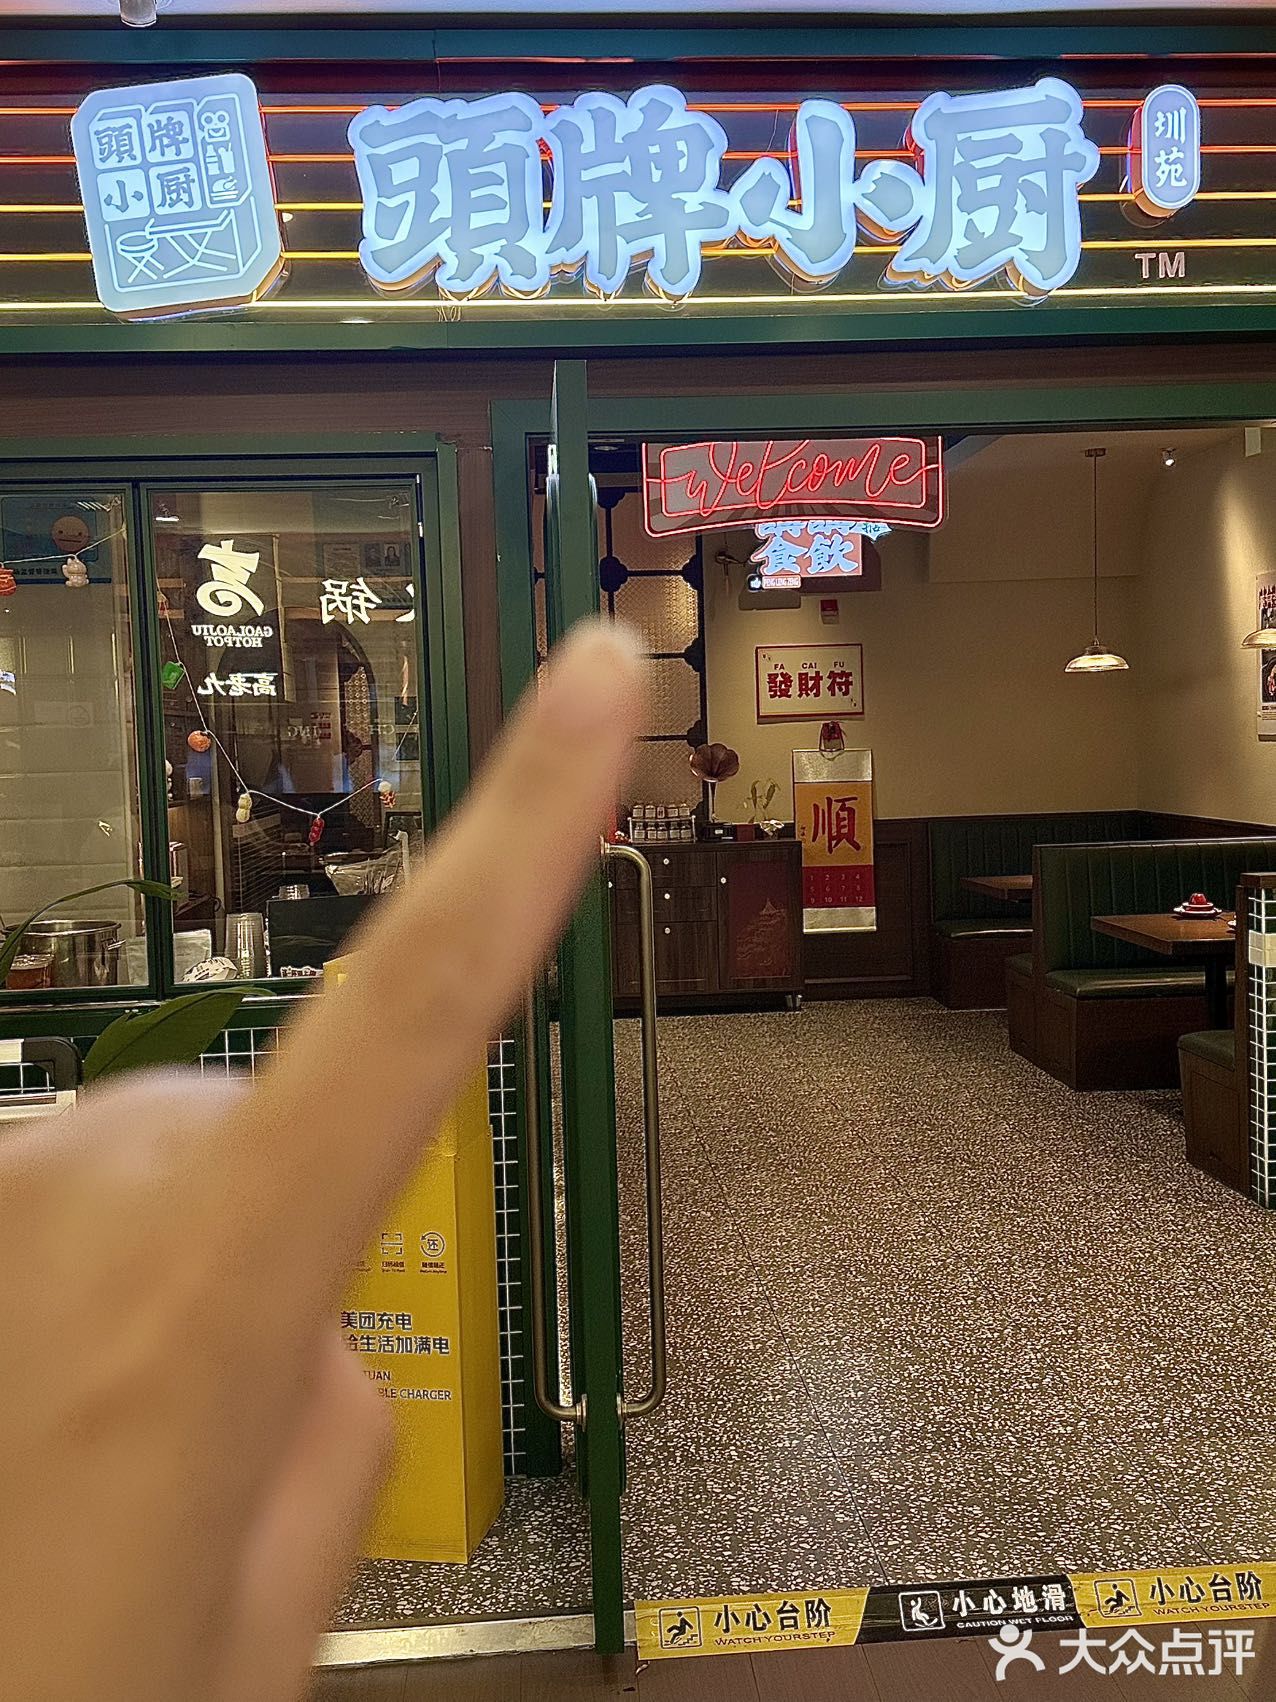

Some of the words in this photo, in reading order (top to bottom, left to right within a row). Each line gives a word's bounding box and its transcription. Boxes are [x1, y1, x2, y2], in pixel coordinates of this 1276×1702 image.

[95, 114, 190, 164] 頭牌
[1154, 105, 1188, 189] 圳苑
[103, 167, 197, 214] 小厨
[350, 82, 1096, 295] 頭牌小厨
[1134, 251, 1186, 279] TM
[767, 670, 854, 698] 發財符
[774, 663, 785, 671] FA
[801, 662, 817, 670] CAI
[811, 796, 862, 855] 順
[340, 1311, 412, 1331] 美团充电
[399, 1389, 452, 1401] CHARGER
[952, 1583, 1068, 1618] 小心地滑
[1149, 1570, 1263, 1606] 小心台阶
[714, 1597, 832, 1634] 小心台阶
